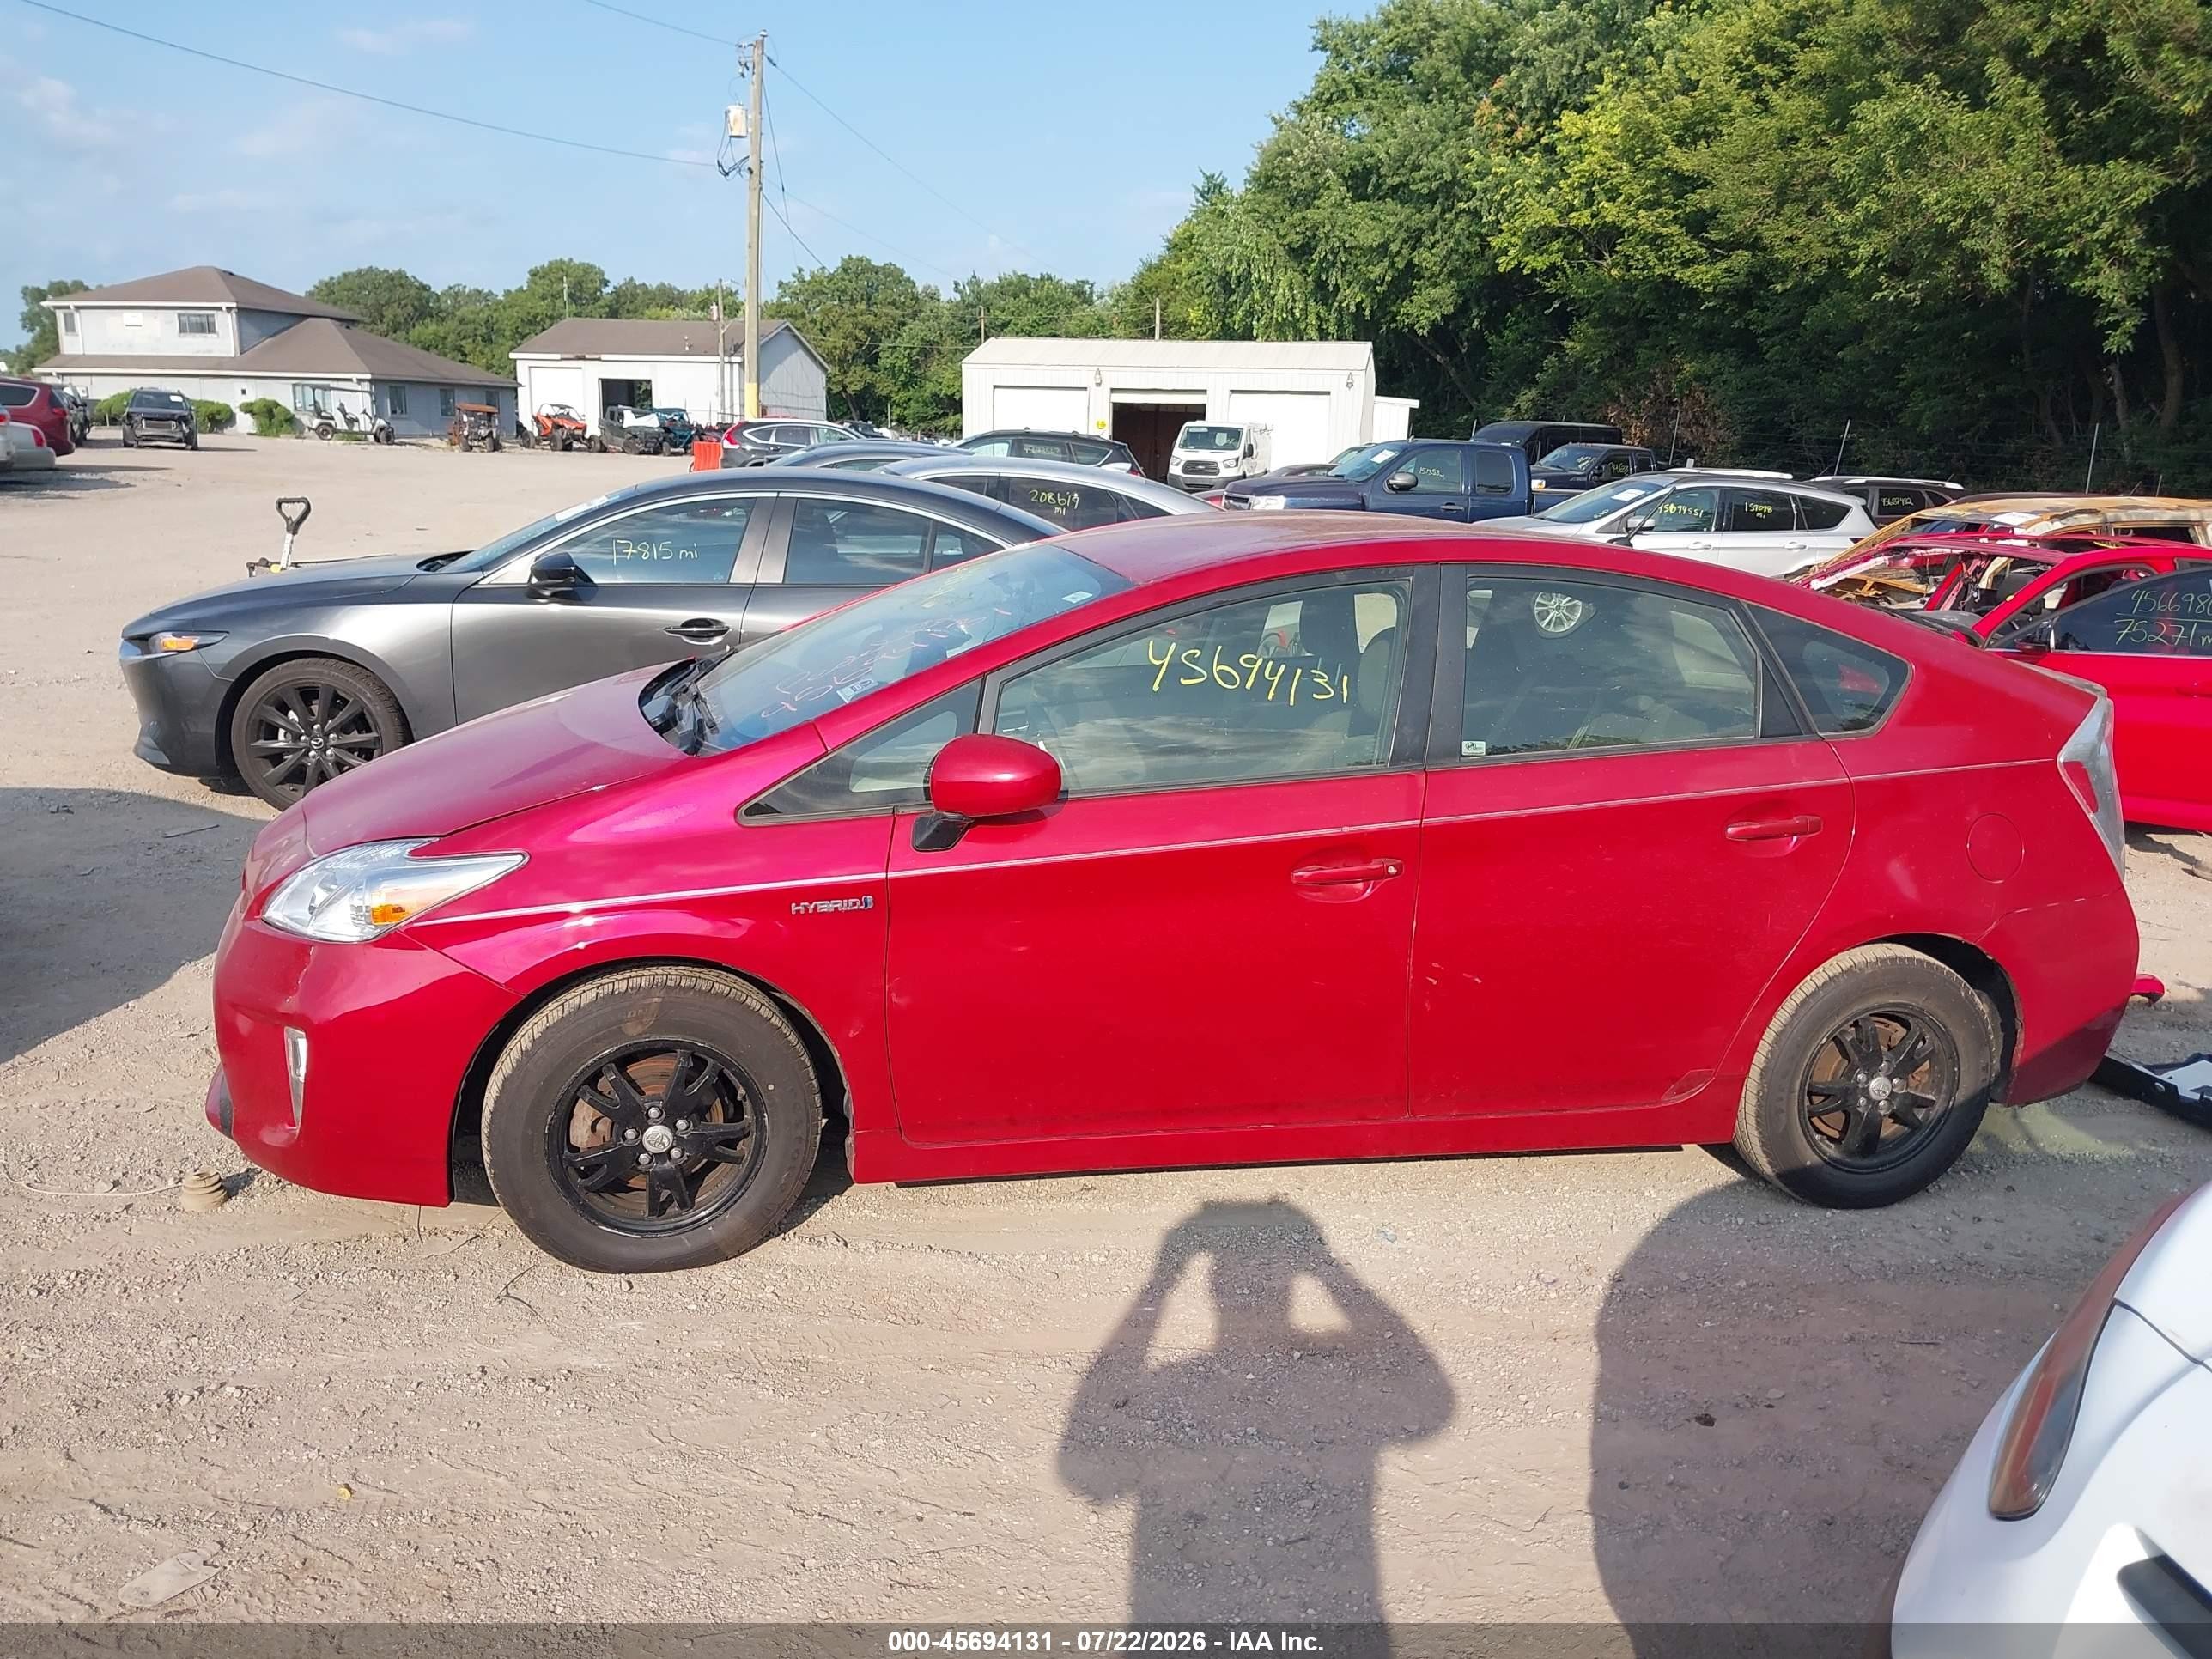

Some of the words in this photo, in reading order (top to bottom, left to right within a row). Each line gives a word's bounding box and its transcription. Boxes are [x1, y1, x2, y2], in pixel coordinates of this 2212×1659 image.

[1029, 489, 1080, 510] 208619
[612, 538, 673, 567] 17815
[678, 543, 698, 560] mi
[791, 898, 862, 915] HYBRID
